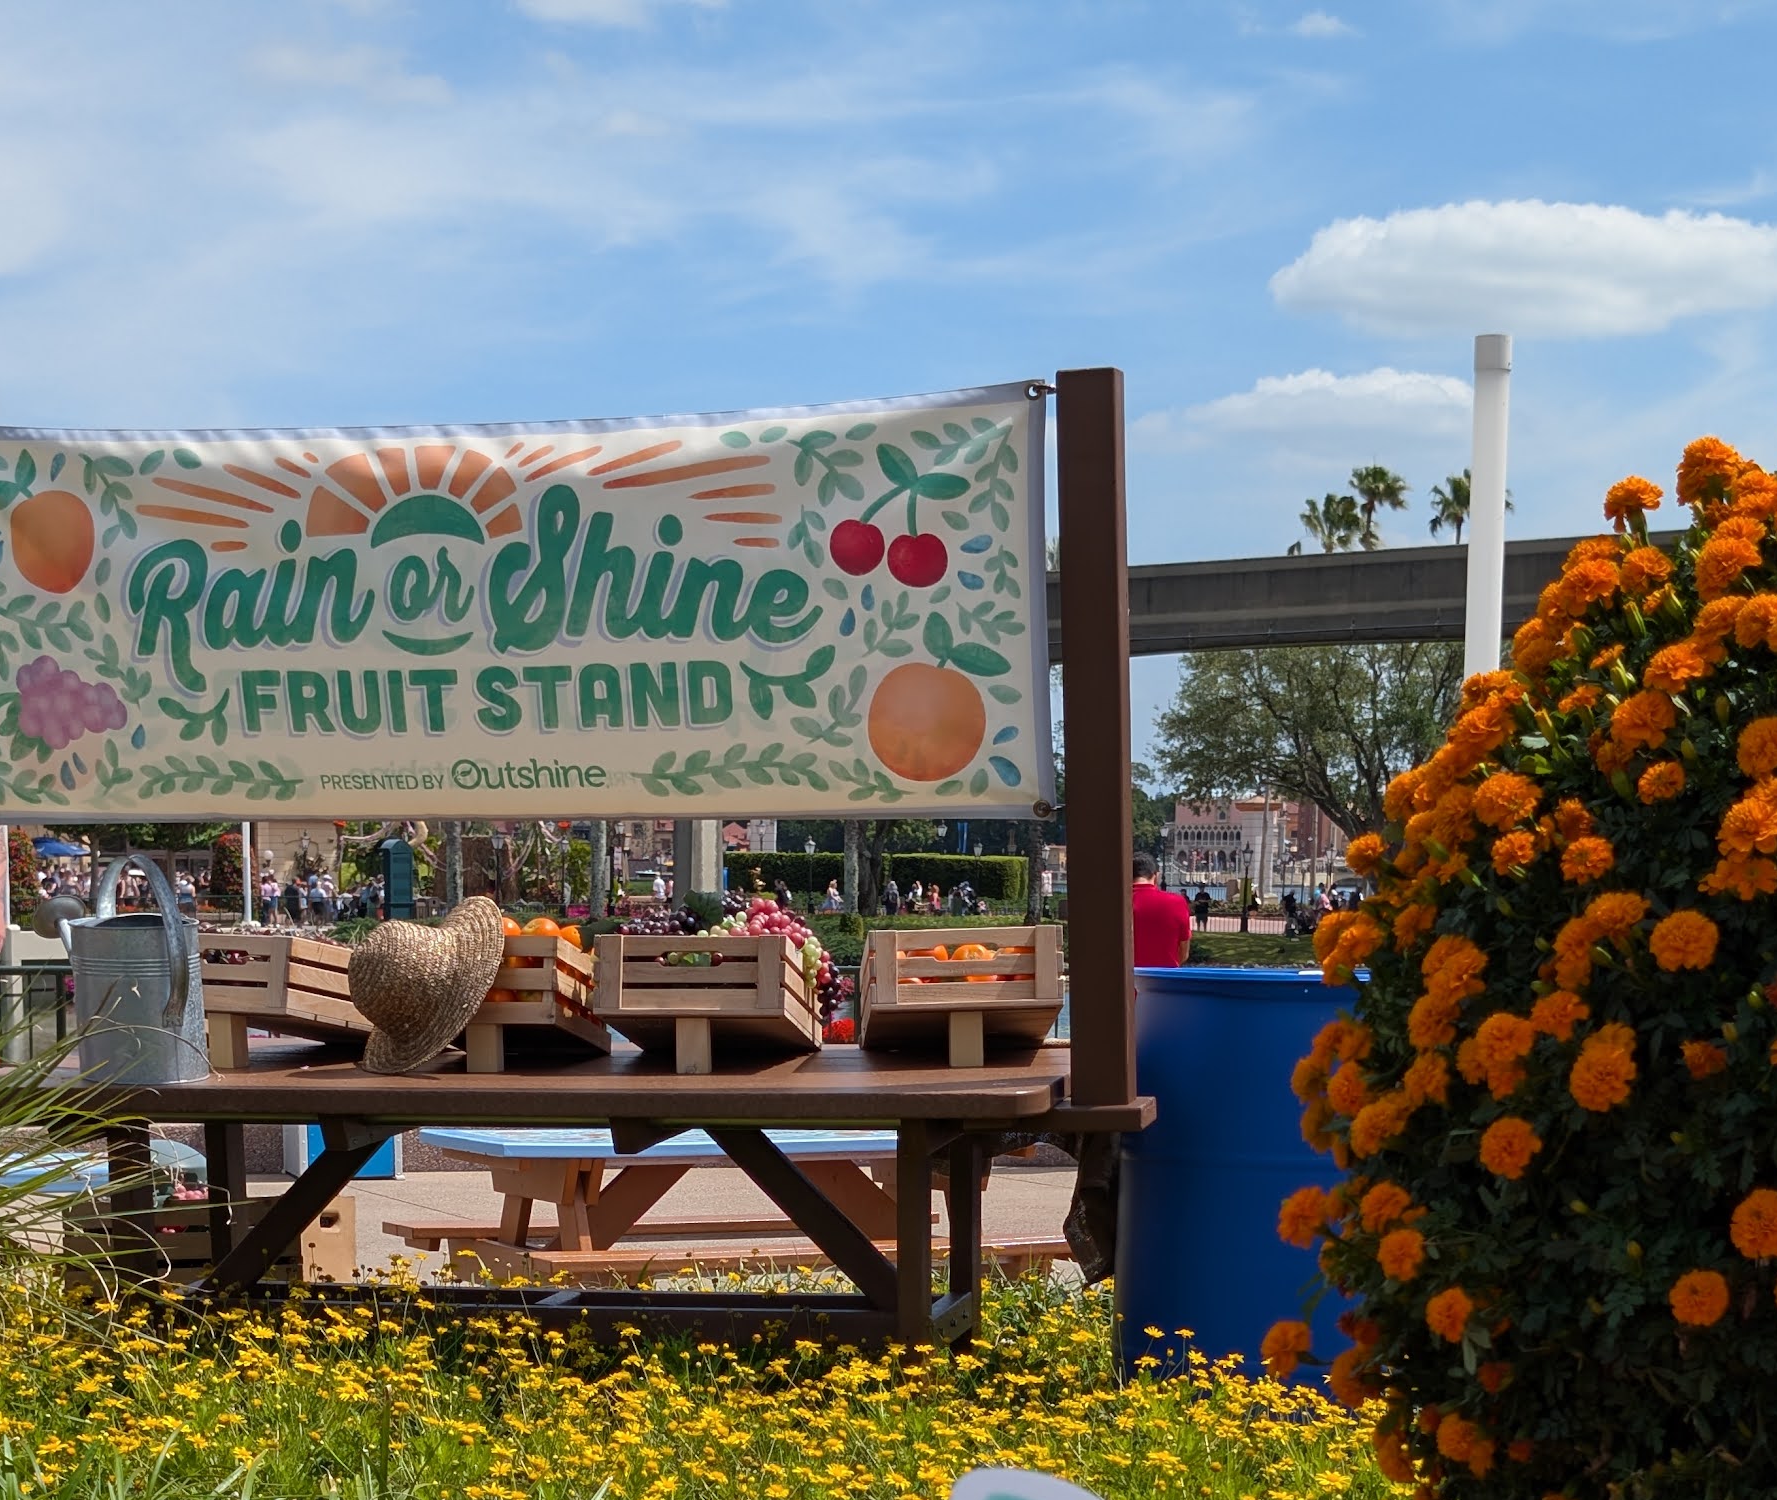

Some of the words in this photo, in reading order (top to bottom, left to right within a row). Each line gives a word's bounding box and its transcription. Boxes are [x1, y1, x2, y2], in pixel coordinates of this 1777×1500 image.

[128, 519, 375, 692] Rain
[384, 545, 474, 622] or
[485, 484, 822, 654] Shine
[240, 668, 458, 733] FRUIT
[476, 660, 734, 732] STAND
[320, 774, 419, 791] PRESENTED
[423, 774, 445, 790] BY
[451, 759, 607, 790] Outshine
